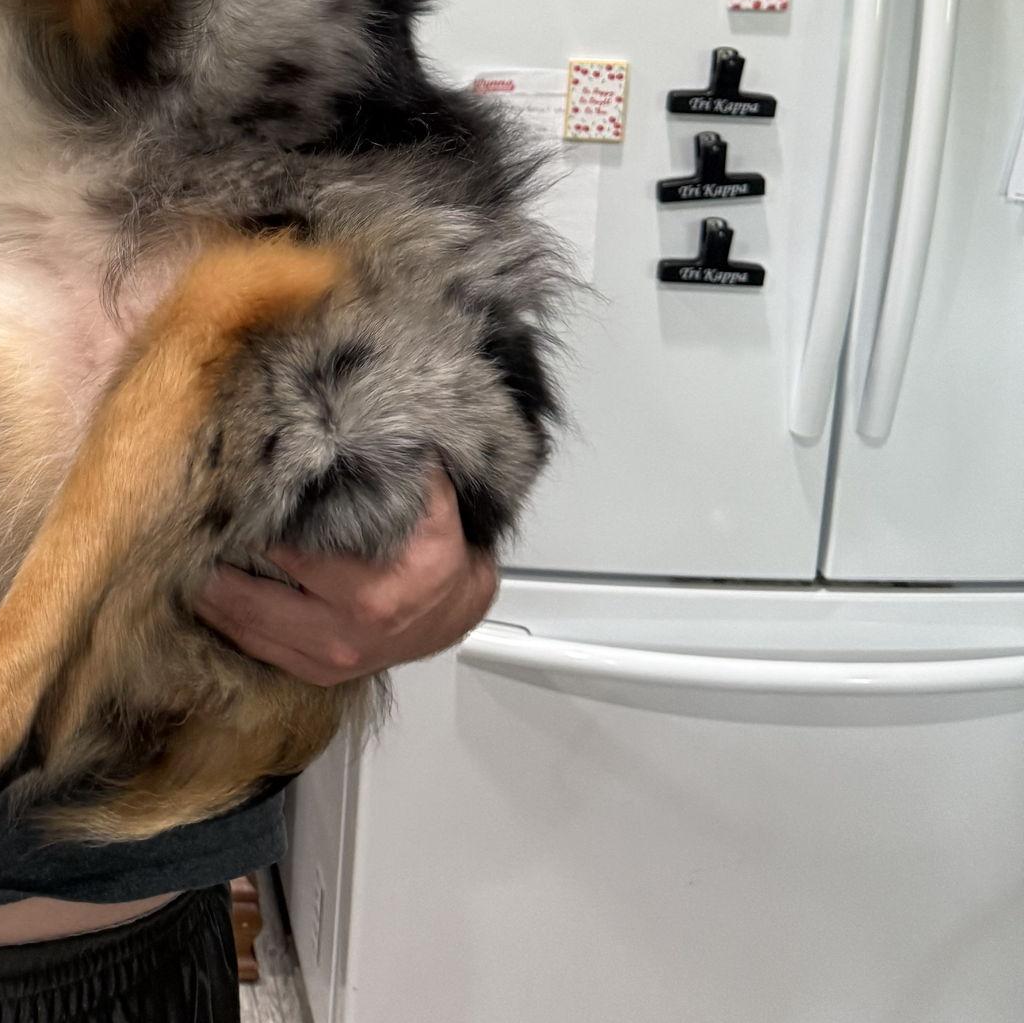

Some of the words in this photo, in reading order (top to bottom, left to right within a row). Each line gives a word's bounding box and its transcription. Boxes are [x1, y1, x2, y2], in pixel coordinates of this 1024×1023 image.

[688, 97, 710, 110] Tri
[713, 98, 760, 114] Kappa
[678, 185, 700, 199] Tri
[703, 183, 749, 198] Kappa
[679, 267, 701, 280] Tri
[703, 268, 749, 284] Kappa
